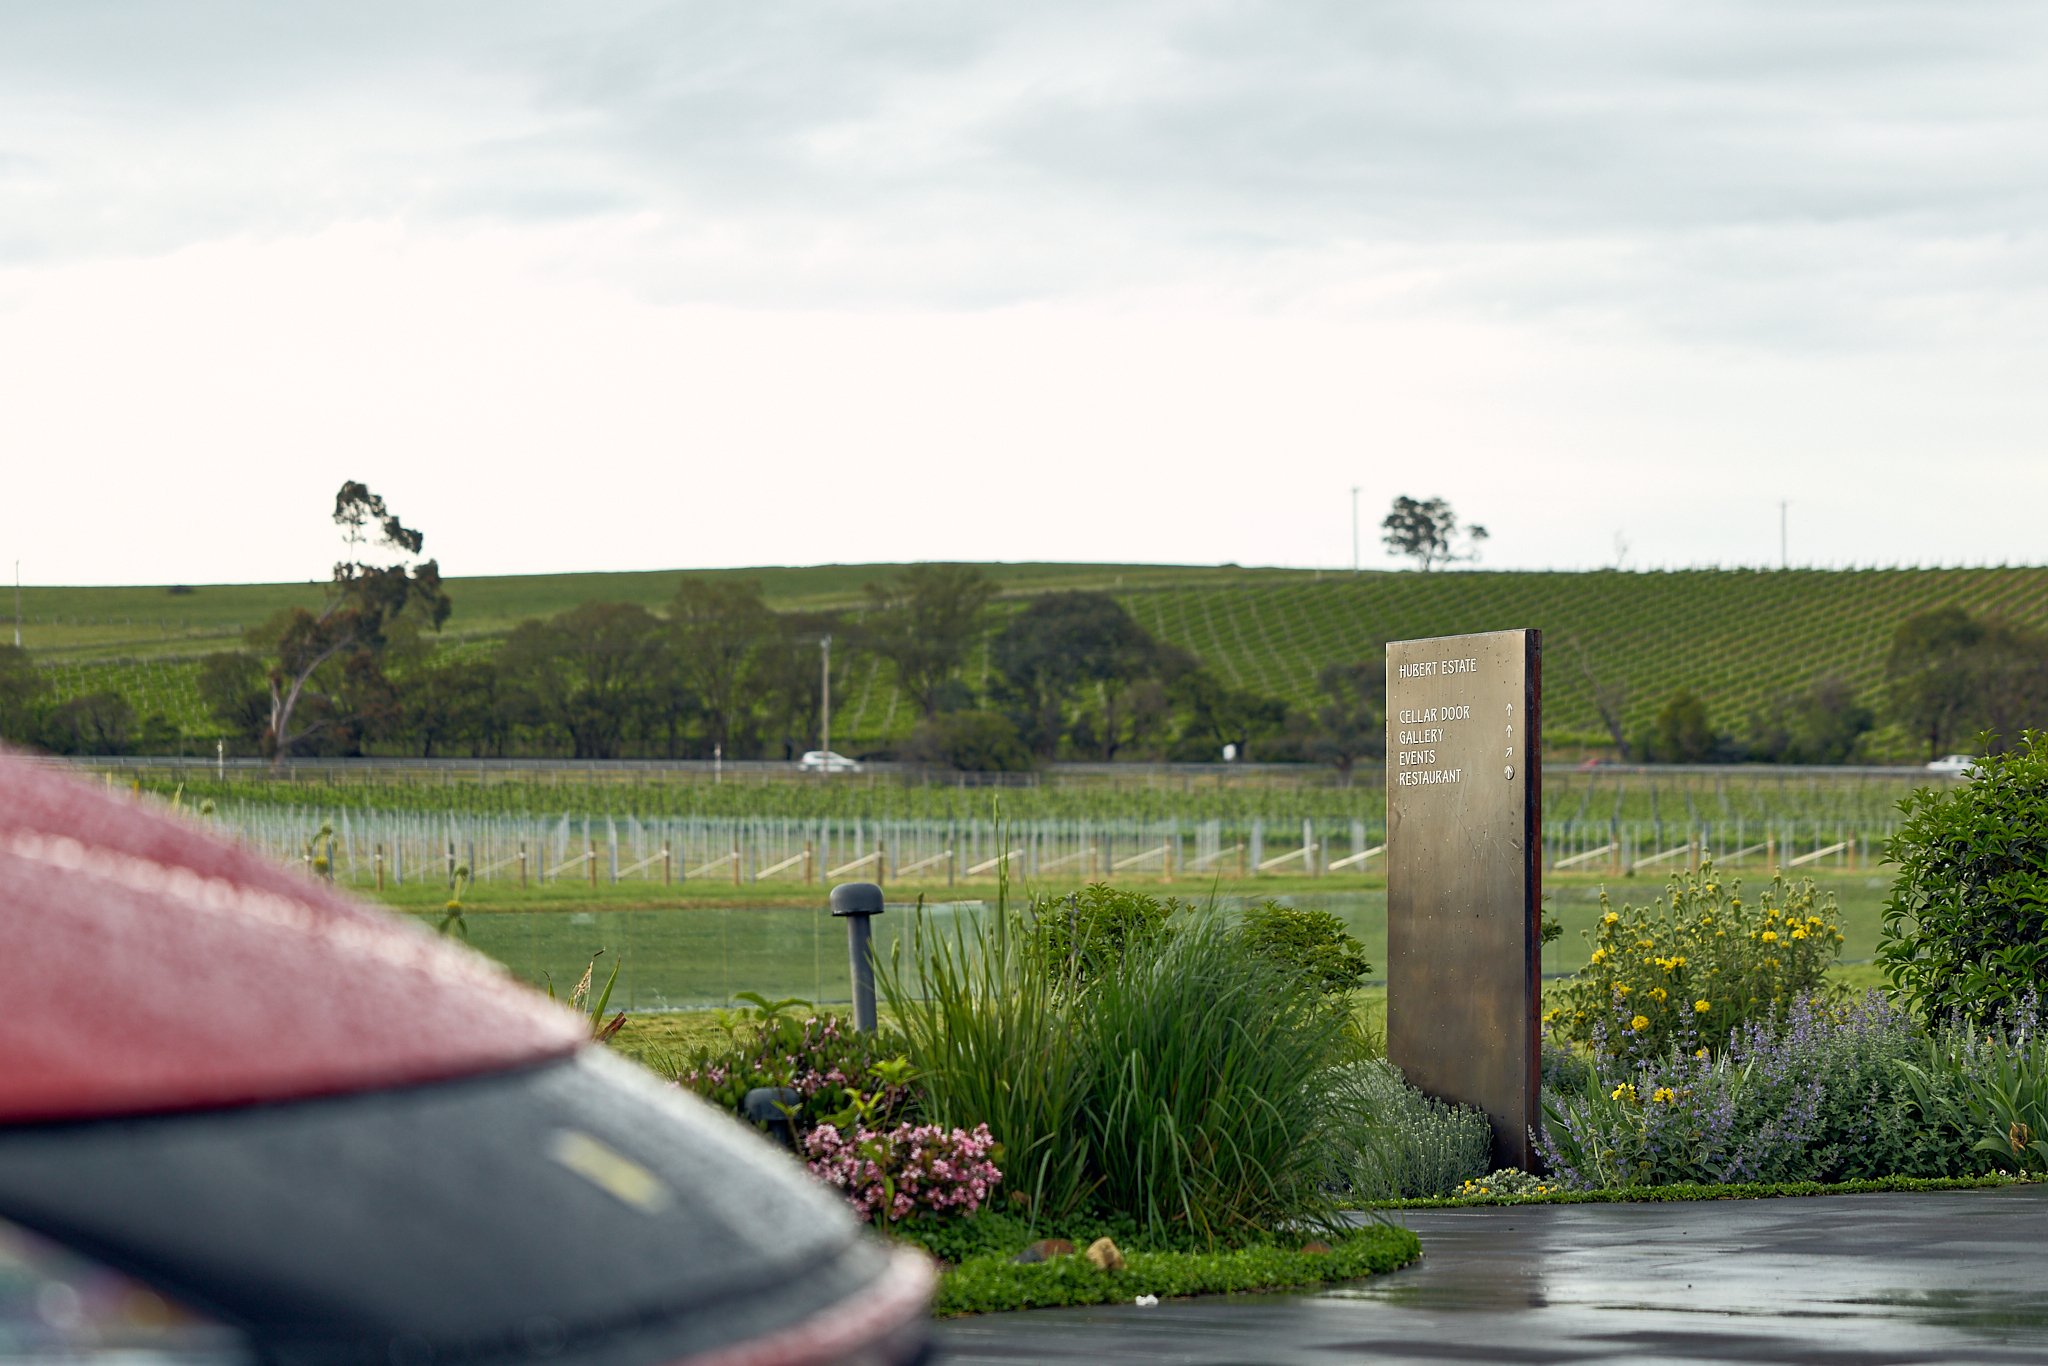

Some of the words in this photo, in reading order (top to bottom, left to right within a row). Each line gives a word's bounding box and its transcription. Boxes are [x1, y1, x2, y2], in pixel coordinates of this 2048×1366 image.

[1399, 661, 1438, 679] HUBERT
[1441, 658, 1477, 675] ESTATE
[1399, 707, 1438, 724] CELLAR
[1441, 705, 1470, 721] DOOR
[1399, 728, 1444, 745] GALLERY
[1399, 749, 1436, 766] EVENTS
[1399, 768, 1462, 786] RESTAURANT
